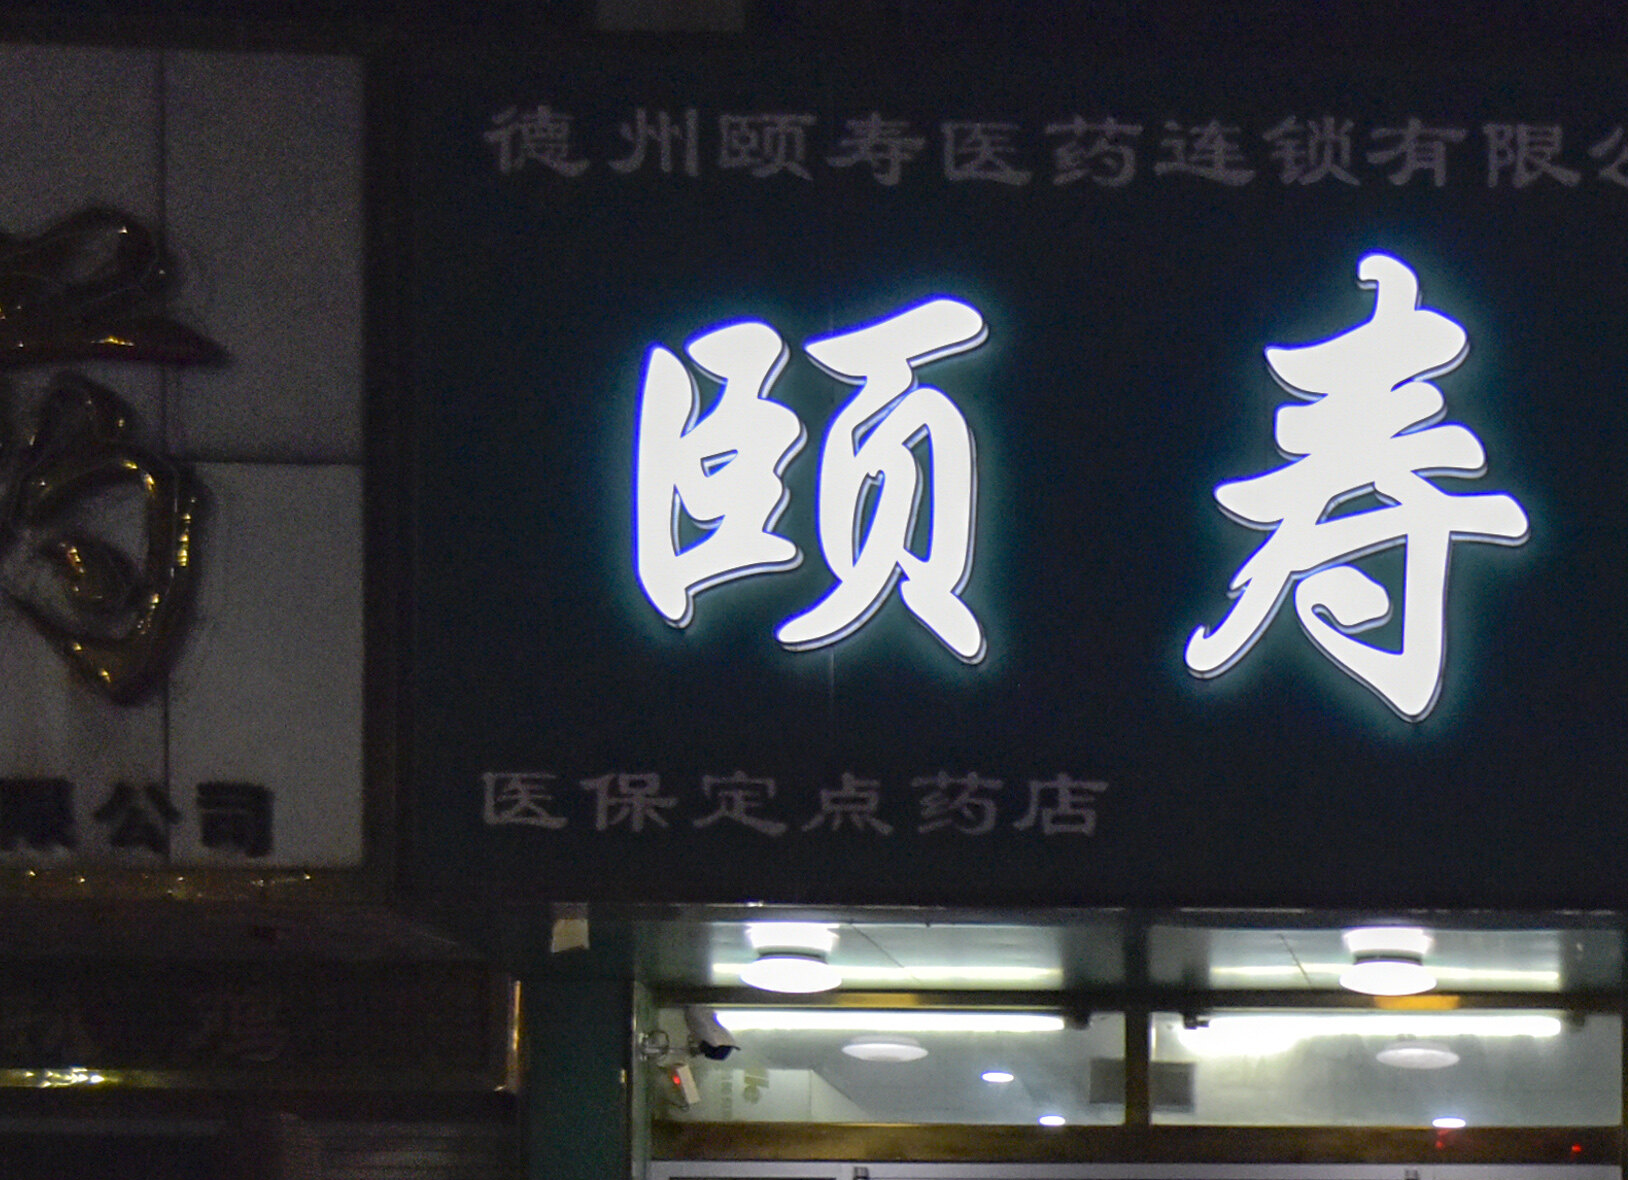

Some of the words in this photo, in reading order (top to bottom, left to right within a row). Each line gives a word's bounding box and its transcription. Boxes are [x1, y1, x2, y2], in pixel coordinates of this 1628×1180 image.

[482, 771, 1108, 837] 医保定点药店
